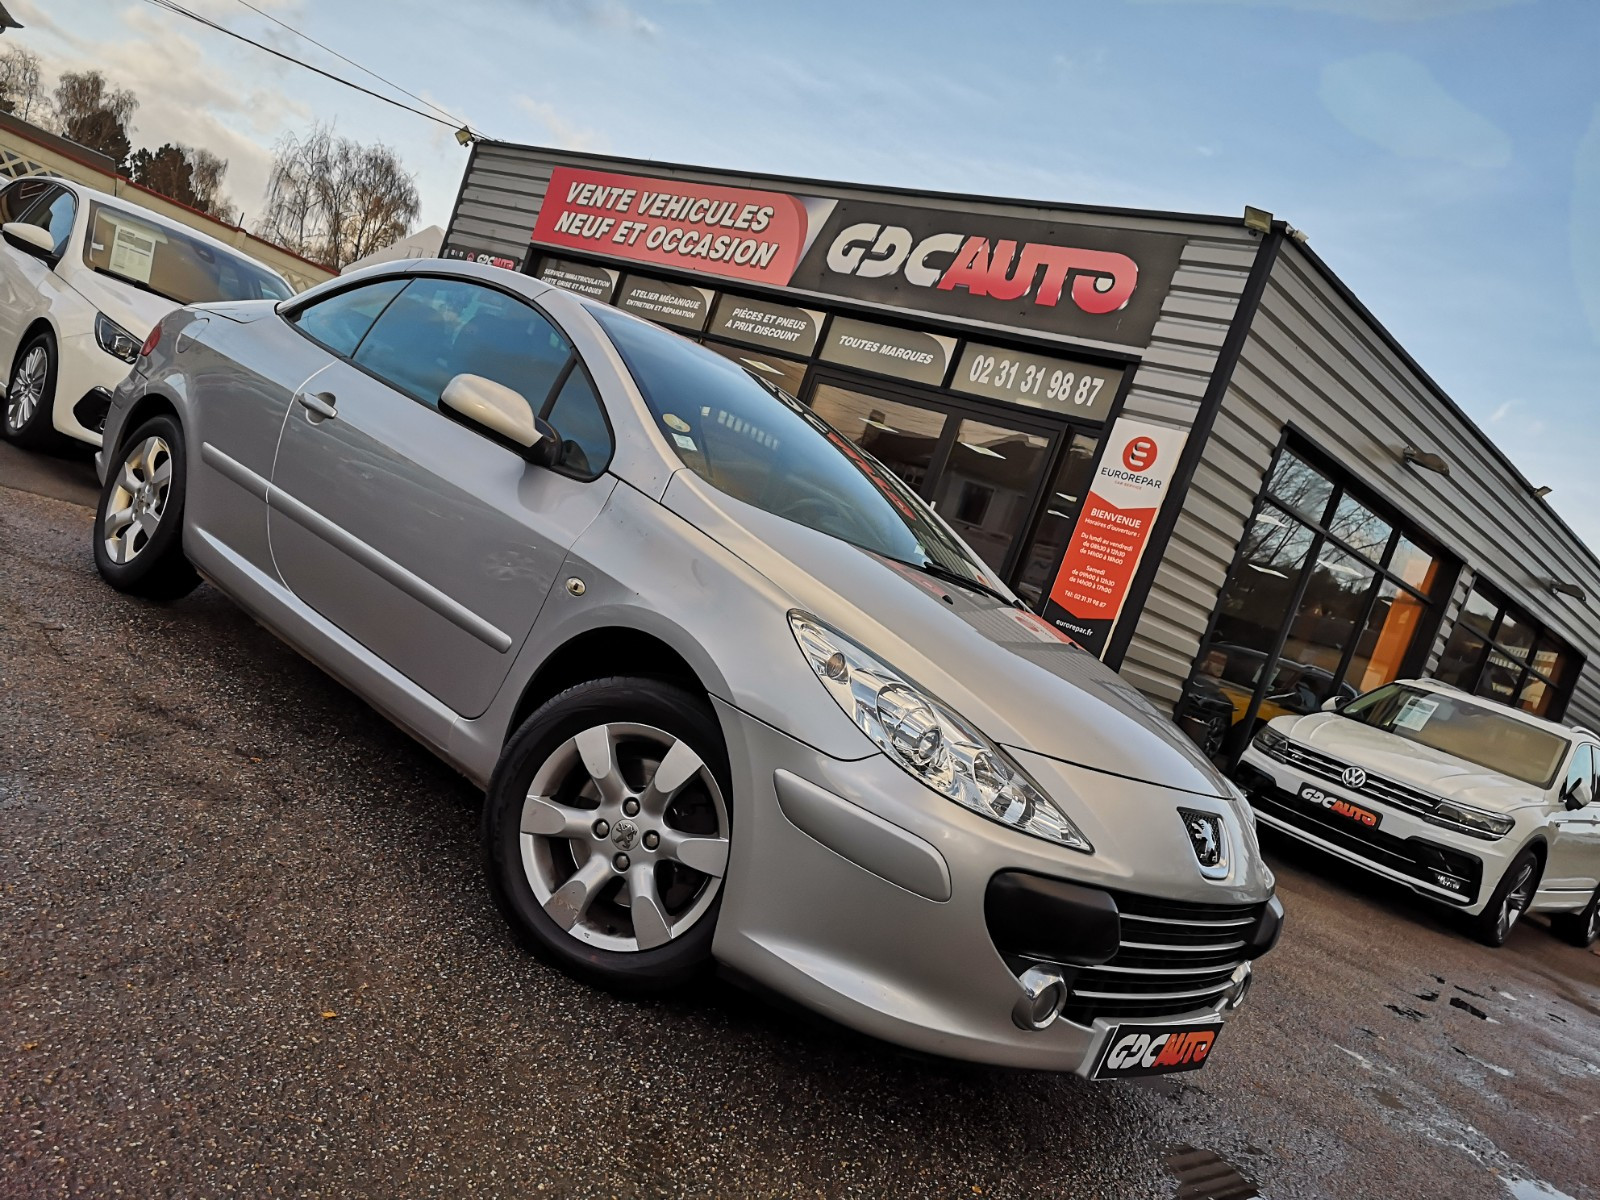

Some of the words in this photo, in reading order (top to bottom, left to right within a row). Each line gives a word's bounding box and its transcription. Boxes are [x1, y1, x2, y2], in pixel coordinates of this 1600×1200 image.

[566, 182, 637, 212] VENTE
[637, 191, 775, 231] VEHICULES
[554, 211, 616, 238] NEUF
[612, 221, 648, 245] ET
[646, 226, 779, 268] OCCASION
[544, 268, 565, 279] SERVICE
[565, 272, 611, 288] IMMATRICULATION
[557, 279, 572, 289] GRISE
[572, 282, 579, 290] ET
[578, 284, 603, 296] PLAQUES
[626, 299, 655, 310] ENTRETIEN
[661, 306, 696, 319] RÉPARATION
[630, 289, 660, 302] ATELIER
[659, 294, 701, 309] MÉCANIQUE
[732, 308, 764, 322] PIÈCES
[763, 312, 777, 324] ET
[776, 316, 807, 330] PNEUS
[733, 321, 755, 333] PRIX
[753, 325, 801, 342] DISCOUNT
[839, 335, 880, 353] TOUTES
[879, 344, 934, 365] MARQUES
[969, 354, 996, 384] 02
[994, 360, 1020, 389] 31
[1020, 364, 1046, 395] 31
[1046, 370, 1075, 401] 98
[1074, 376, 1105, 407] 87
[1100, 467, 1162, 489] EUROREPAR
[1084, 518, 1107, 528] Horaires
[1106, 523, 1138, 537] d'ouverture
[1090, 507, 1142, 529] BIENVENUE
[1089, 534, 1102, 542] lundi
[1109, 541, 1133, 551] vendredi
[1086, 565, 1106, 576] Samedi
[1055, 619, 1094, 636] eurorepar.fr
